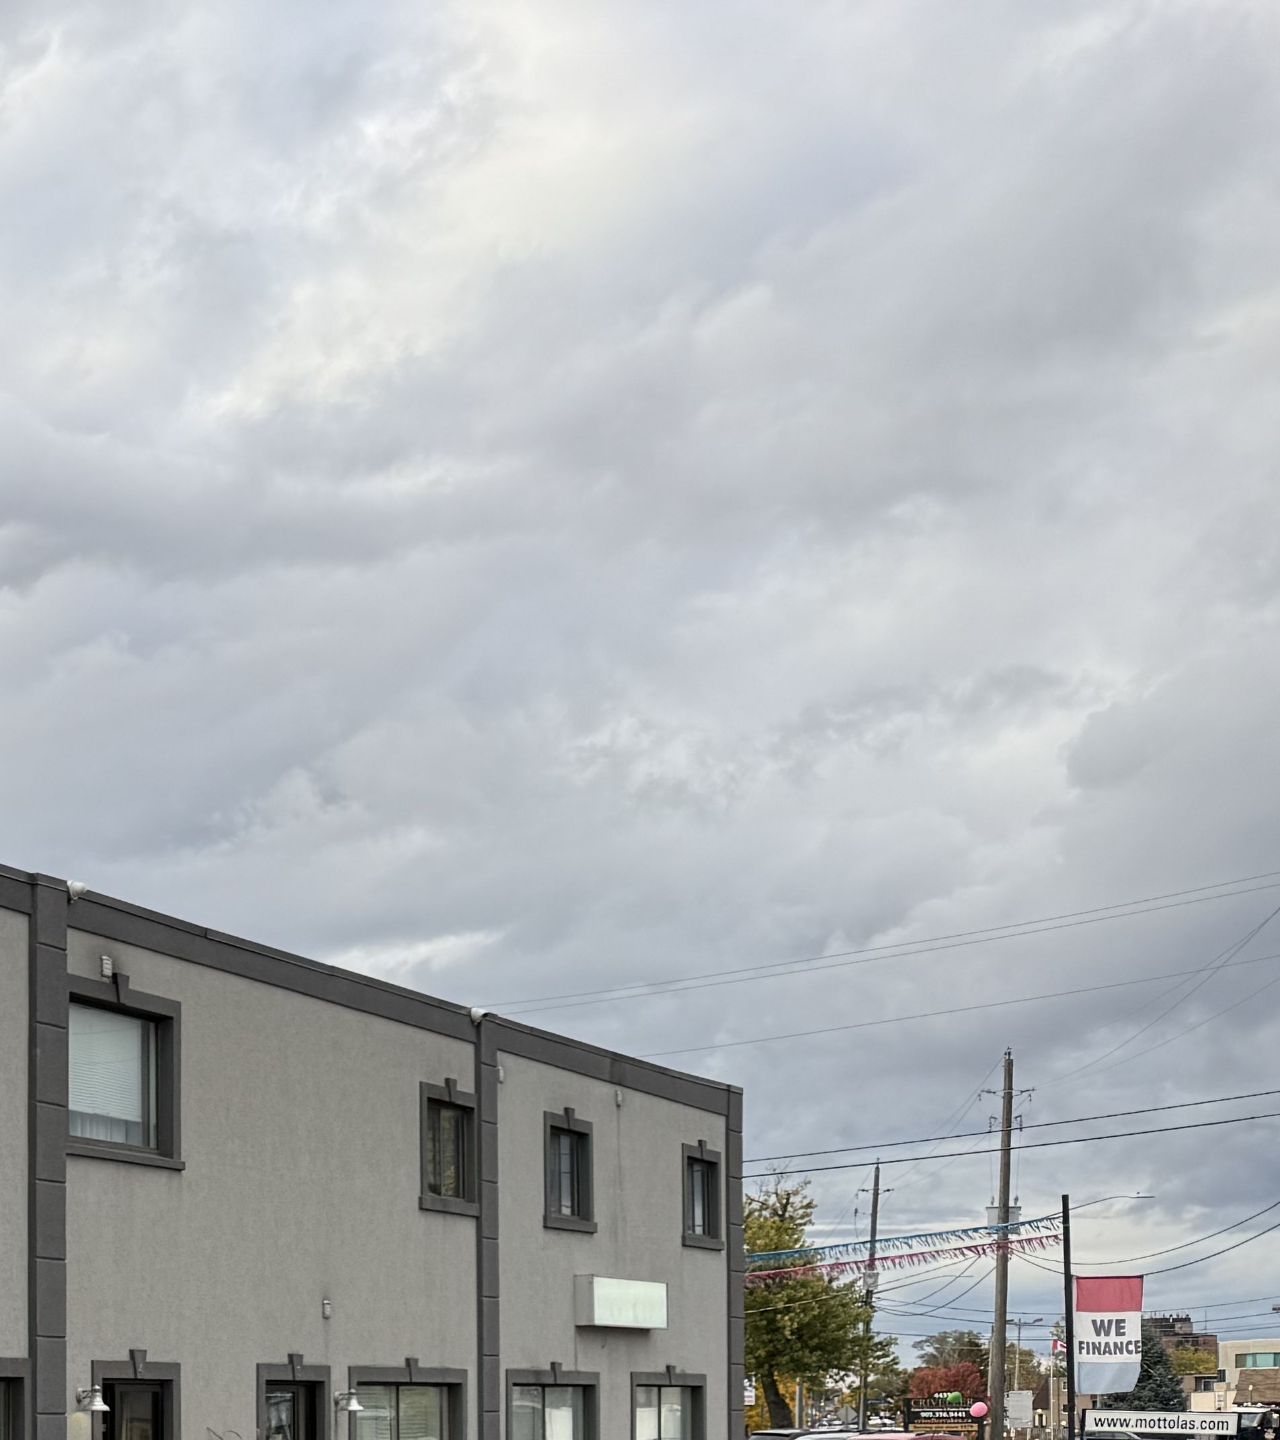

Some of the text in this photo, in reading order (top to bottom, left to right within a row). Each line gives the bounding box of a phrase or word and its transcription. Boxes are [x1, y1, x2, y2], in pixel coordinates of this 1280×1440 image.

[1091, 1319, 1126, 1337] WE
[1078, 1339, 1142, 1356] FINANCE
[1094, 1414, 1229, 1431] www.mottolas.com
